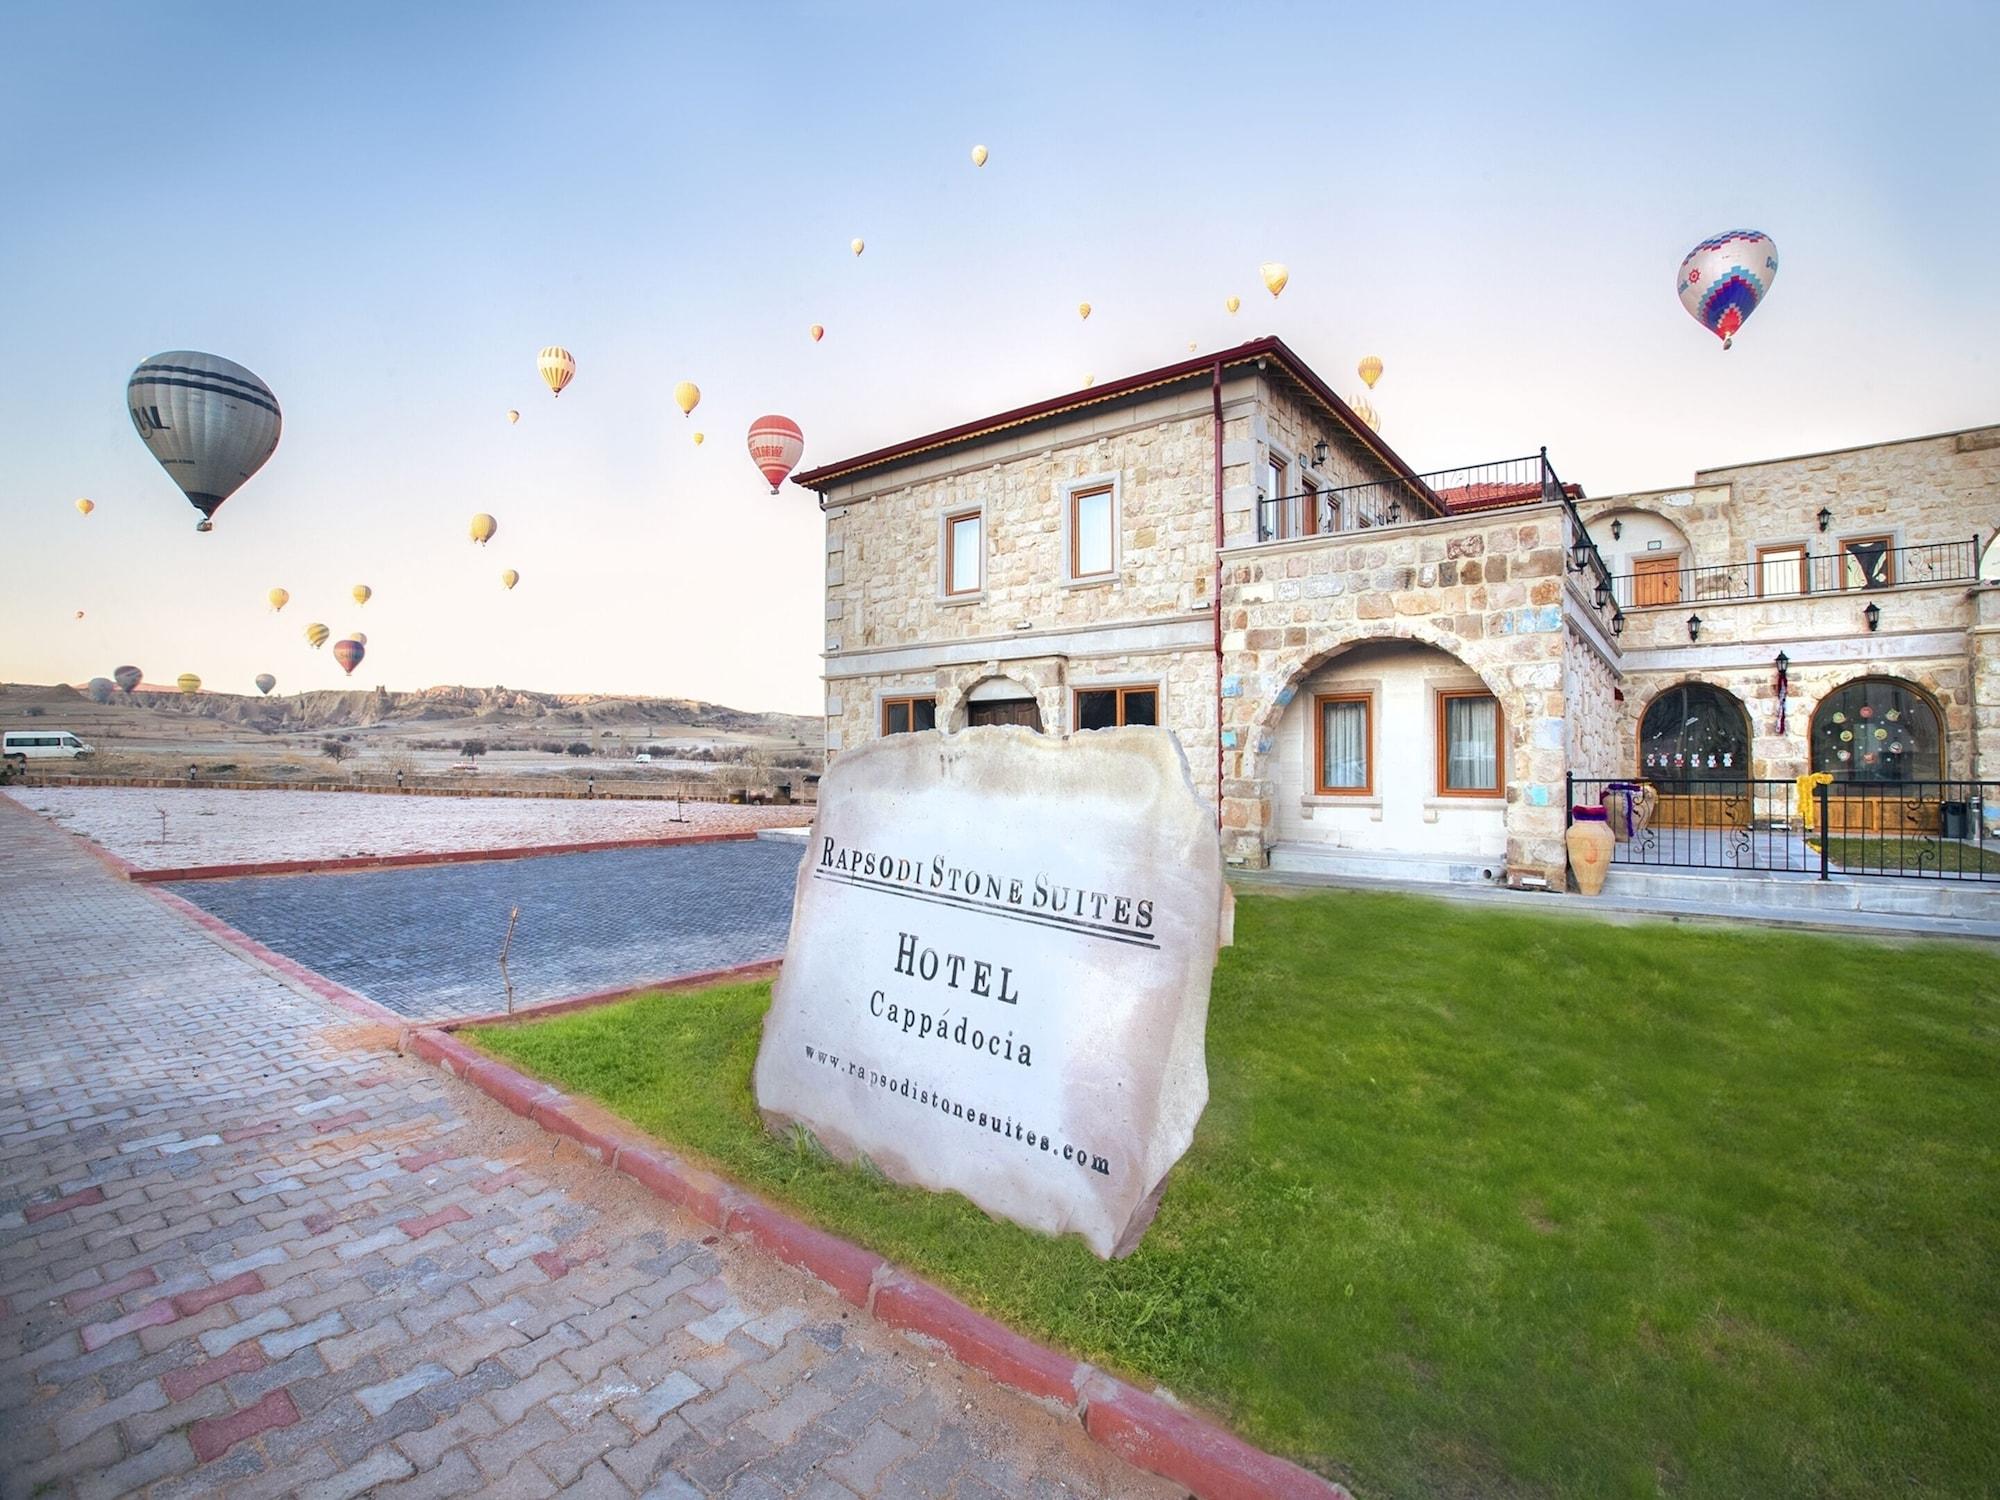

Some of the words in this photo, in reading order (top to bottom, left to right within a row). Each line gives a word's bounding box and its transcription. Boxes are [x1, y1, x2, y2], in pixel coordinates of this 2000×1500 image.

[820, 836, 923, 884] RAPSODI
[929, 855, 1023, 905] STONE
[1032, 871, 1154, 929] SUITES
[894, 932, 1019, 1005] HOTEL
[804, 1044, 1110, 1175] www.rapsodistonesuites.com
